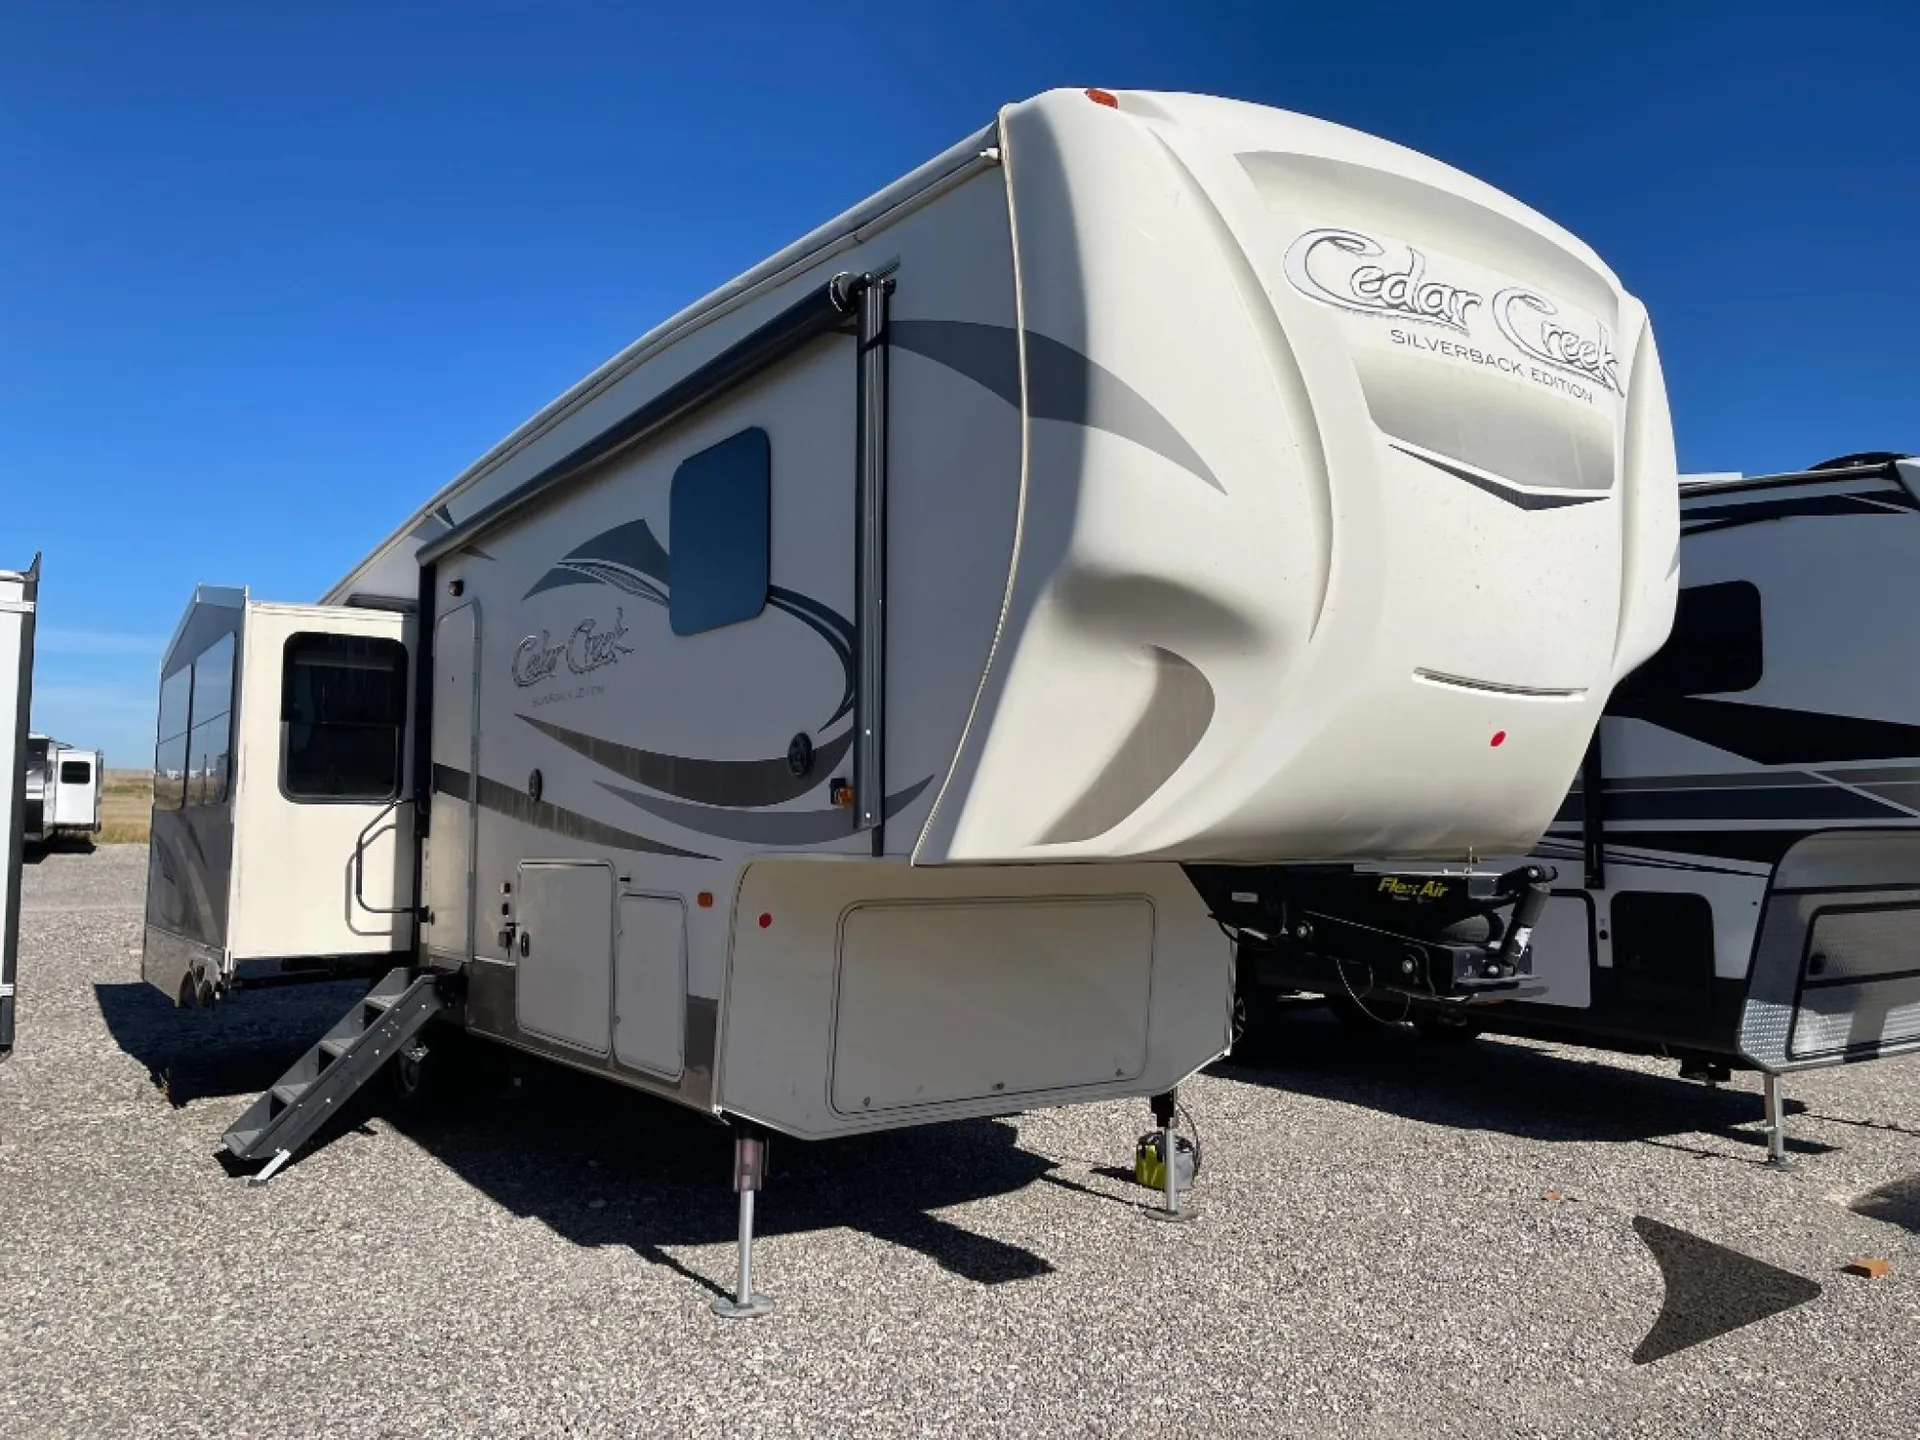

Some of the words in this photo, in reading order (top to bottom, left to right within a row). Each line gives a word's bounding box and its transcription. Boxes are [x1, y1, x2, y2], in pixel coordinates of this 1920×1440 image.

[1282, 228, 1483, 337] Cedar
[1491, 286, 1625, 399] Creek
[1389, 328, 1525, 378] SILVERBACK
[1530, 368, 1594, 404] EDITION
[1419, 880, 1449, 897] Air
